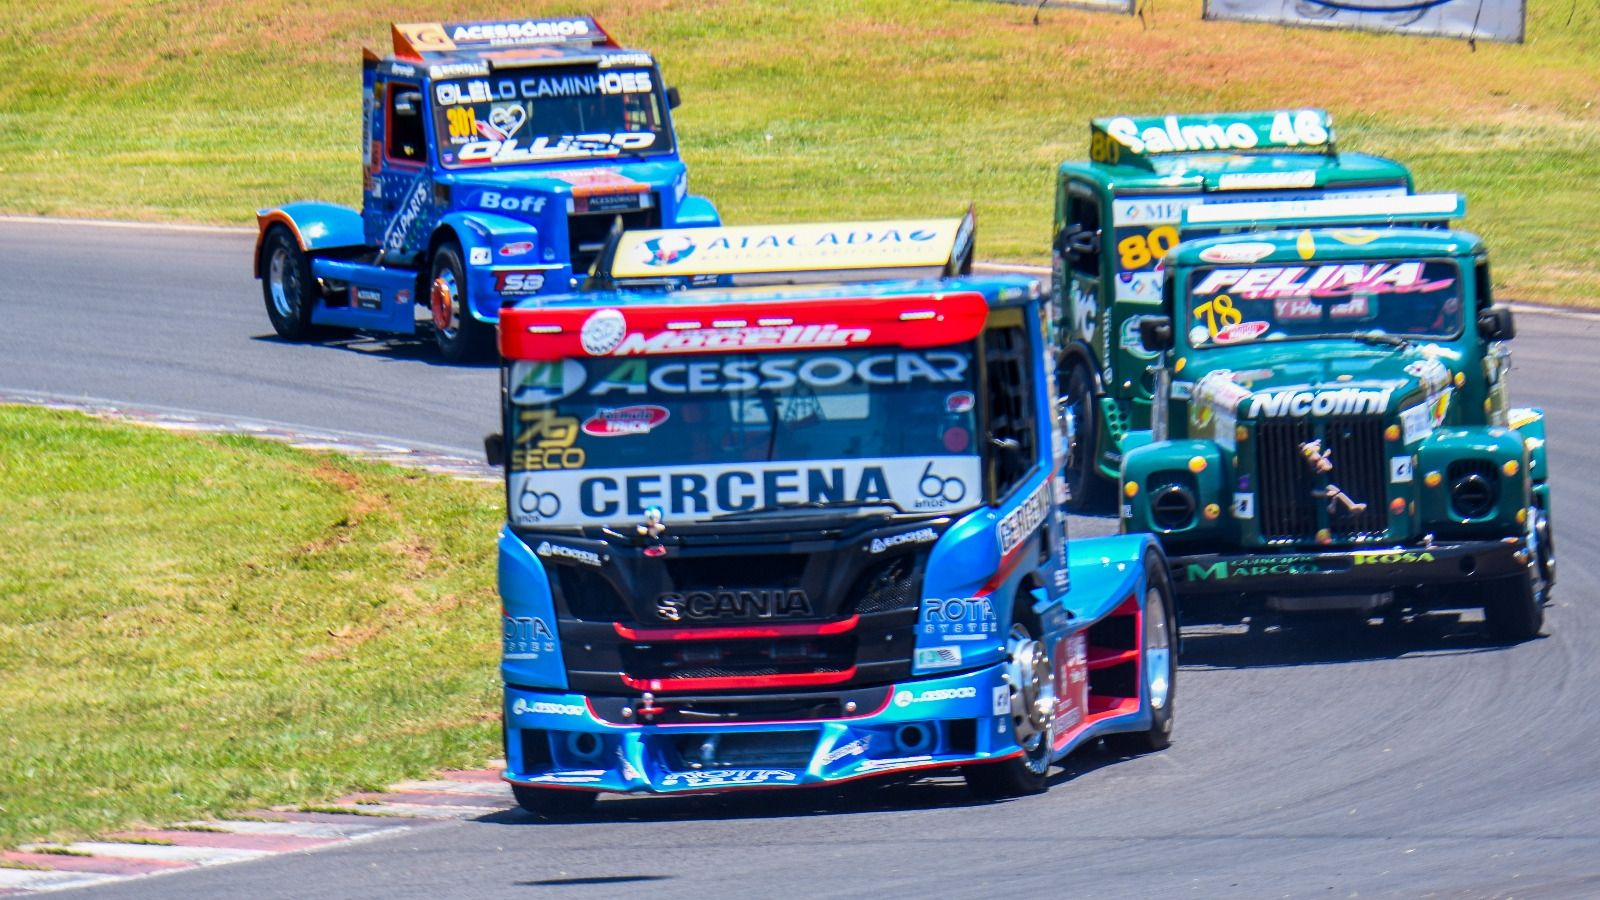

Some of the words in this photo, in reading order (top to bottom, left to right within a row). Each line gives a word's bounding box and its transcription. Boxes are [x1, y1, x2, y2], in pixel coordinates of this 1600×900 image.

[453, 21, 589, 41] ACESSÓRIOS
[520, 71, 652, 97] CAMINHÕES
[446, 106, 477, 137] 301
[1107, 115, 1258, 153] Salmo
[480, 191, 547, 213] Boff
[1118, 225, 1180, 270] 80
[1192, 261, 1424, 295] FELINA
[1193, 294, 1242, 338] 78
[590, 353, 969, 396] ACESSOCAR
[511, 448, 585, 470] SECO
[579, 467, 894, 518] CERCENA
[656, 589, 815, 621] SCANIA
[924, 597, 997, 622] ROTA
[502, 616, 553, 640] OTA
